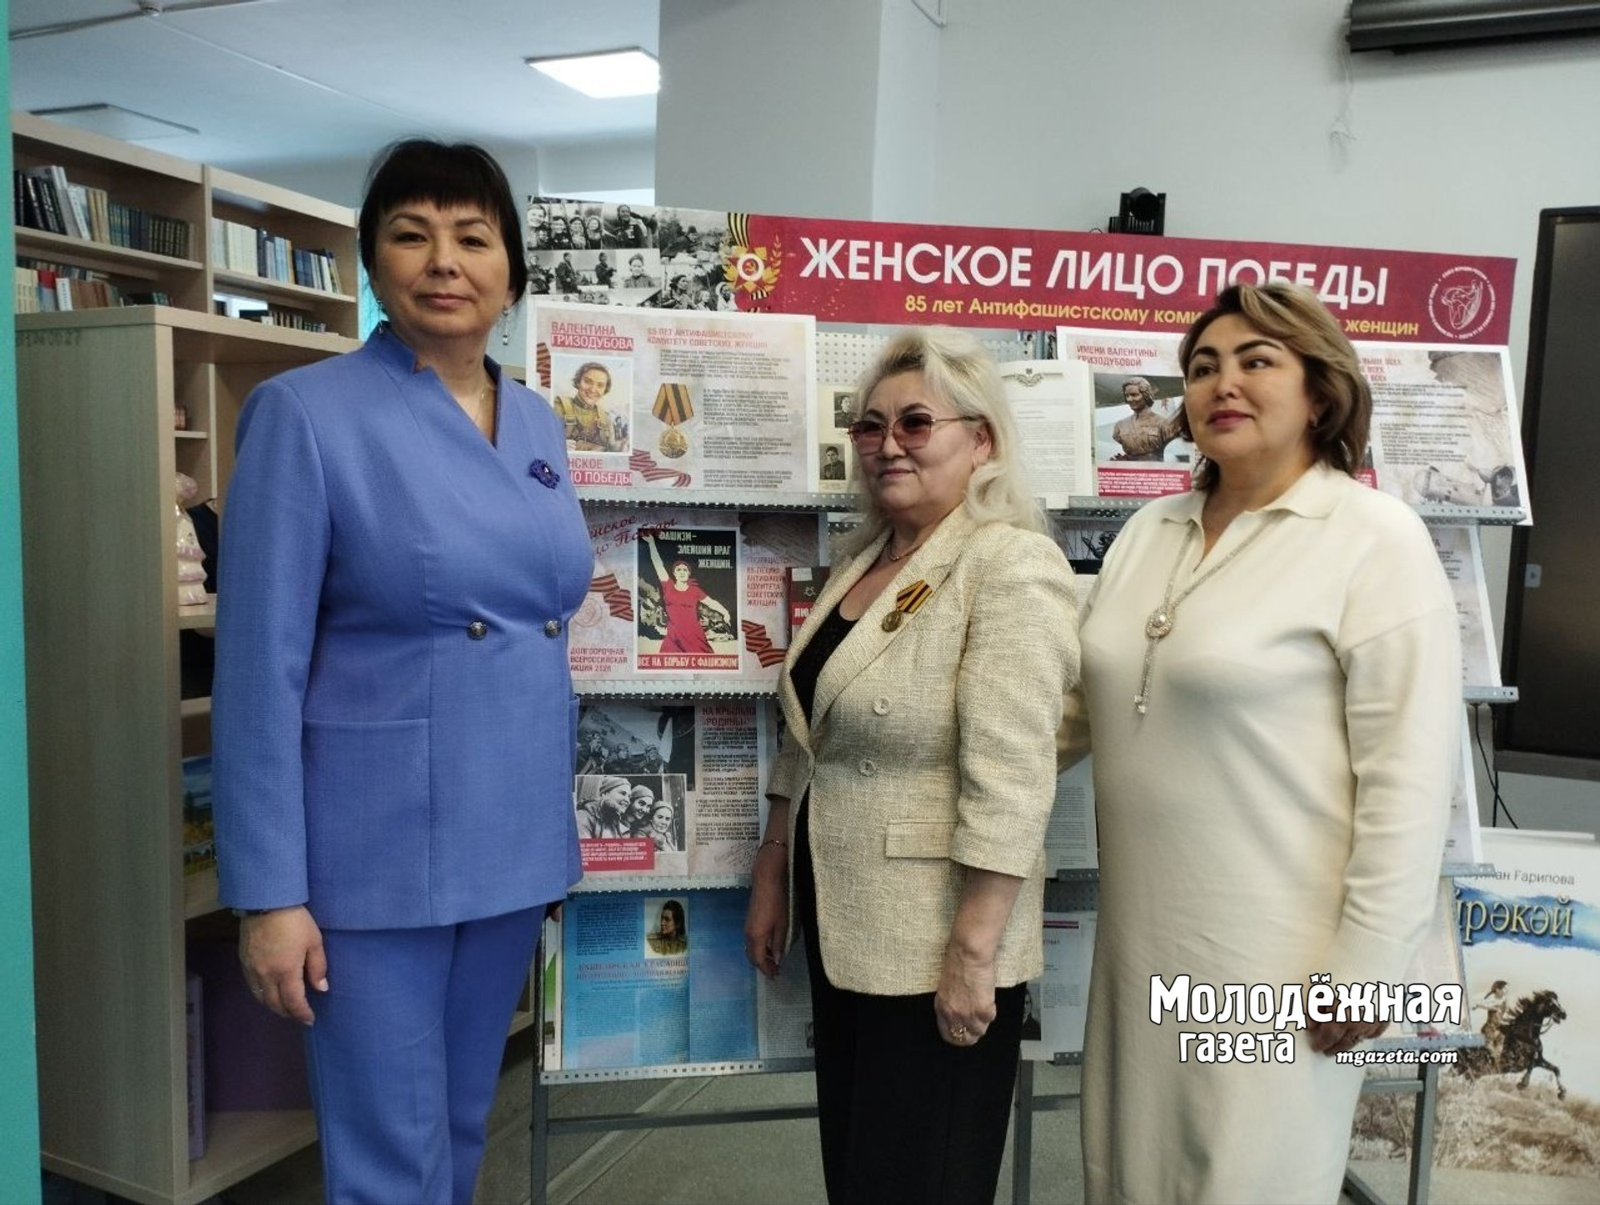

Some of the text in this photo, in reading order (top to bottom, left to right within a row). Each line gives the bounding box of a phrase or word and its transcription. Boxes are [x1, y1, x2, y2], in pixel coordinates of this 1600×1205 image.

[799, 236, 1032, 288] ЖЕНСКОЕ
[1046, 249, 1184, 300] ЛИЦО
[905, 294, 927, 313] 85
[931, 299, 964, 314] лет
[968, 297, 1149, 326] Антифашистскому
[1154, 309, 1201, 324] коми
[1344, 318, 1419, 336] женщин
[551, 321, 616, 336] ВАЛЕНТИНА
[551, 335, 633, 350] ГРИЗОДУБОВА
[1076, 344, 1159, 358] ИМЕНИ ВАЛЕНТИНЫ
[568, 457, 604, 469] НСКОЕ
[585, 471, 633, 486] ПОБЕДЫ
[714, 545, 731, 556] ВРАГ
[651, 657, 662, 667] НА
[691, 657, 697, 667] С
